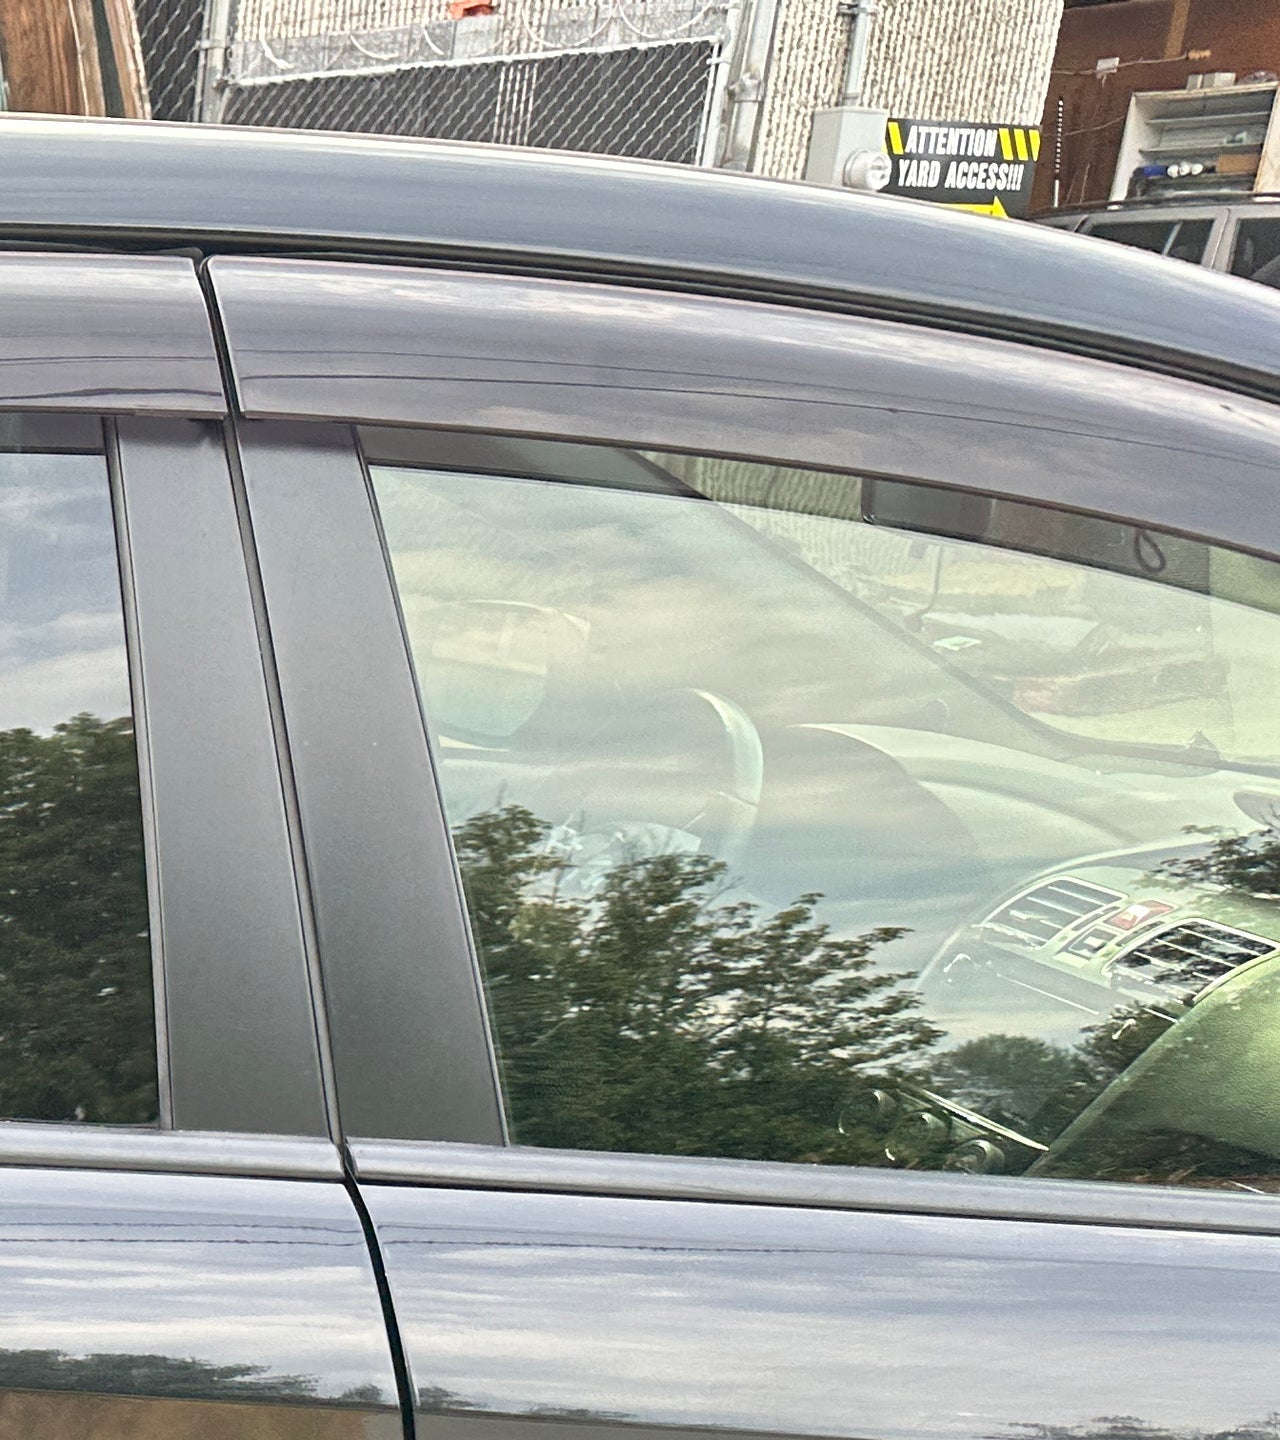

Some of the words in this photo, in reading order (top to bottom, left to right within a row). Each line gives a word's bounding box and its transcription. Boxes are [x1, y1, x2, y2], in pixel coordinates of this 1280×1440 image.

[904, 125, 998, 157] ATTENTION
[898, 159, 940, 188] YARD
[944, 161, 1024, 191] ACCESS!!!
